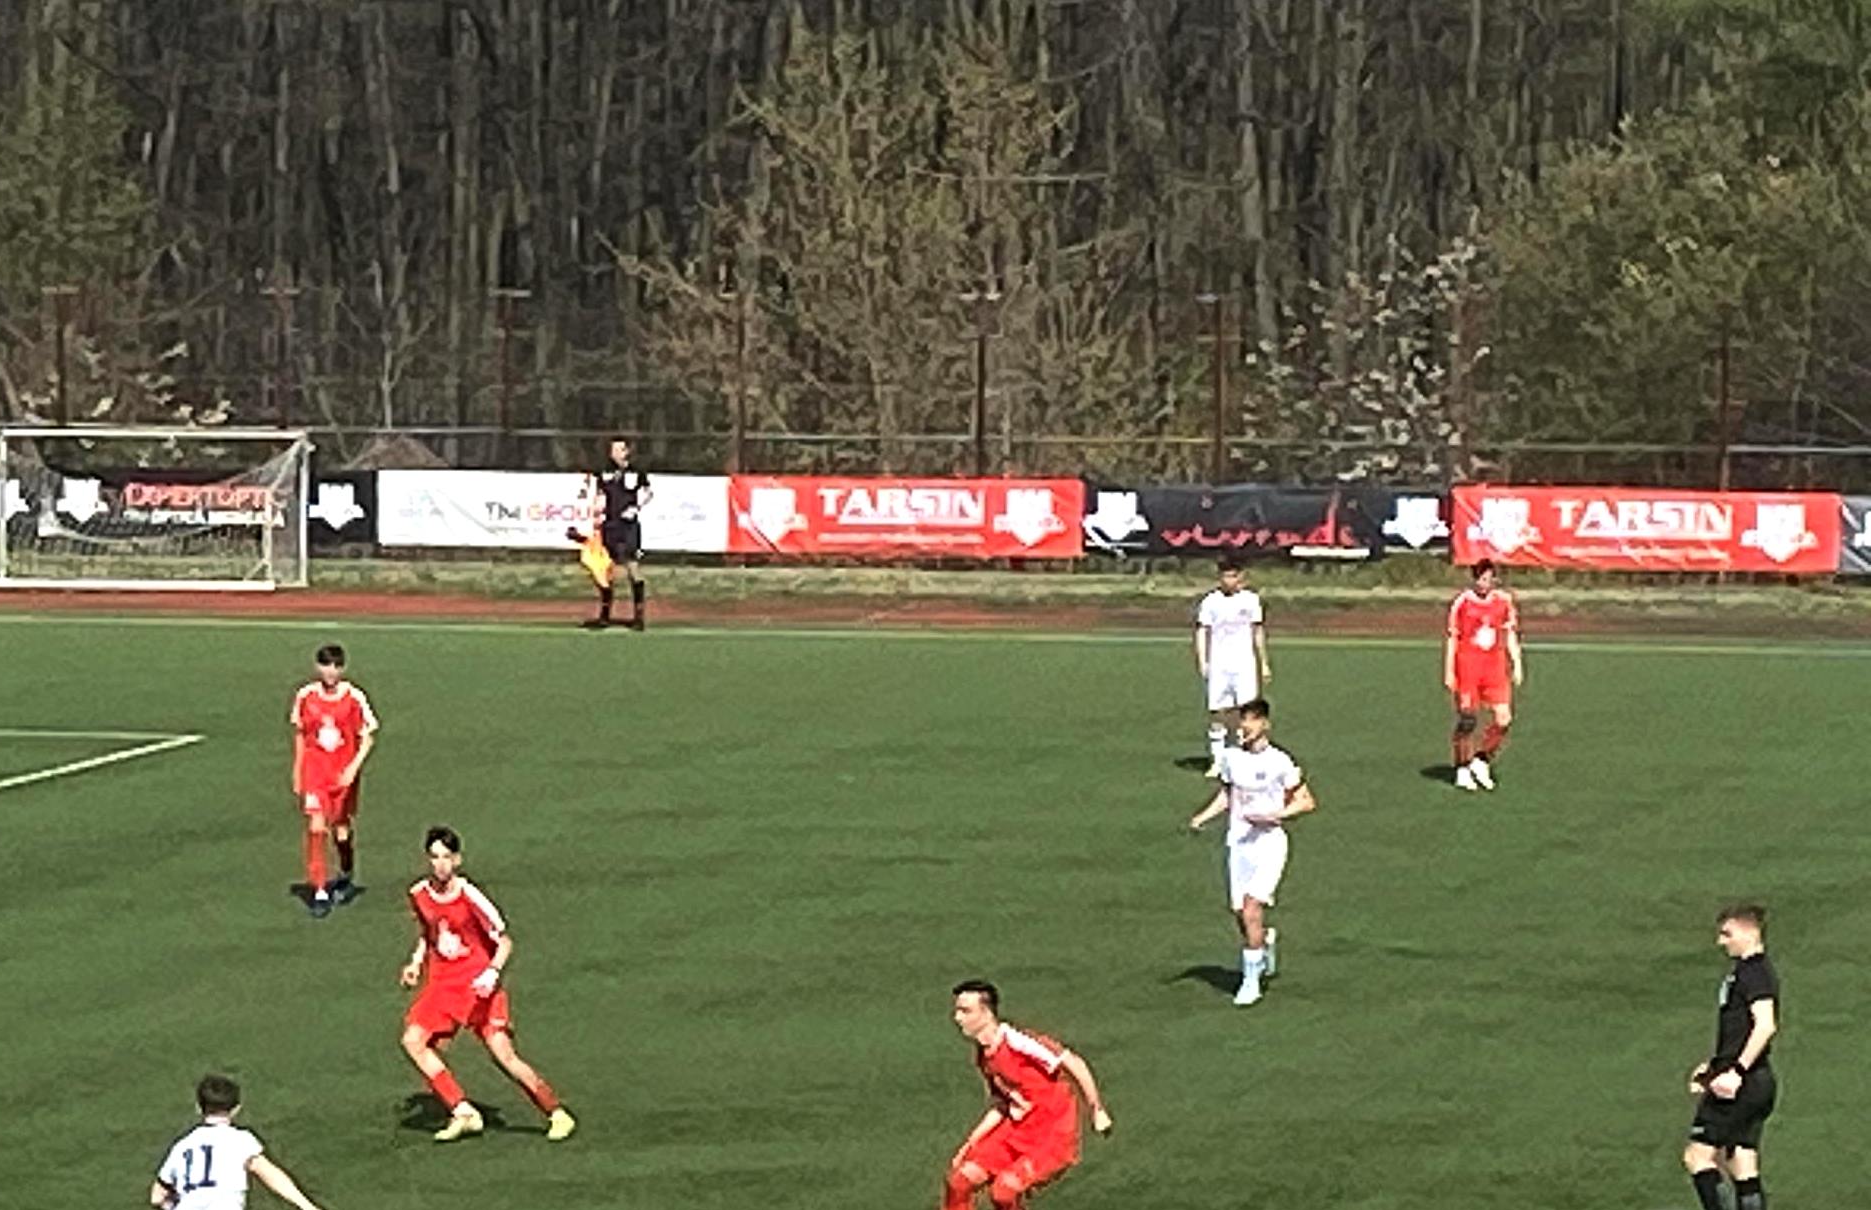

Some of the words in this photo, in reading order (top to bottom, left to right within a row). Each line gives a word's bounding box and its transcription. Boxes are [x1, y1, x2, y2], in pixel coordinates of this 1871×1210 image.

[527, 502, 595, 521] GROU
[817, 487, 986, 526] TARSIN
[1550, 499, 1733, 540] TARSIN
[183, 1144, 217, 1194] 11
